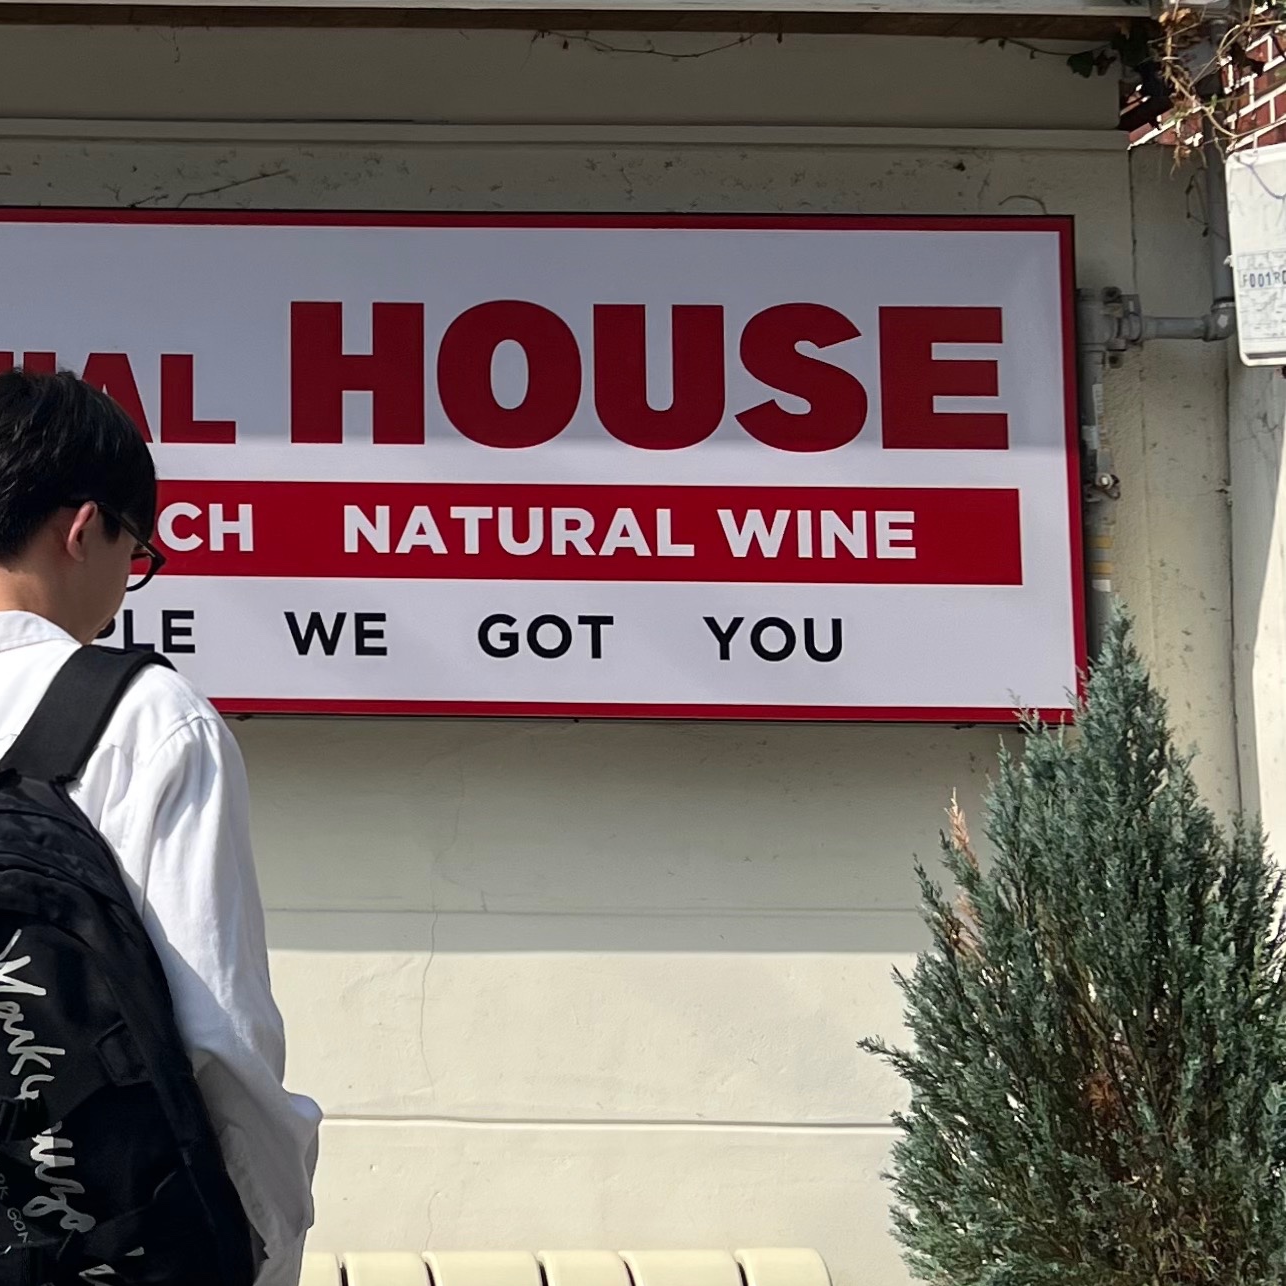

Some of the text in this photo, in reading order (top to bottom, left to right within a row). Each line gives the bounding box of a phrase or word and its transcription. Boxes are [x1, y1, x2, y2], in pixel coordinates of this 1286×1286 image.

[290, 300, 1009, 453] HOUSE
[343, 504, 695, 557] NATURAL
[717, 508, 917, 559] WINE
[283, 611, 389, 657] WE
[477, 612, 614, 660] GOT
[702, 615, 844, 664] YOU
